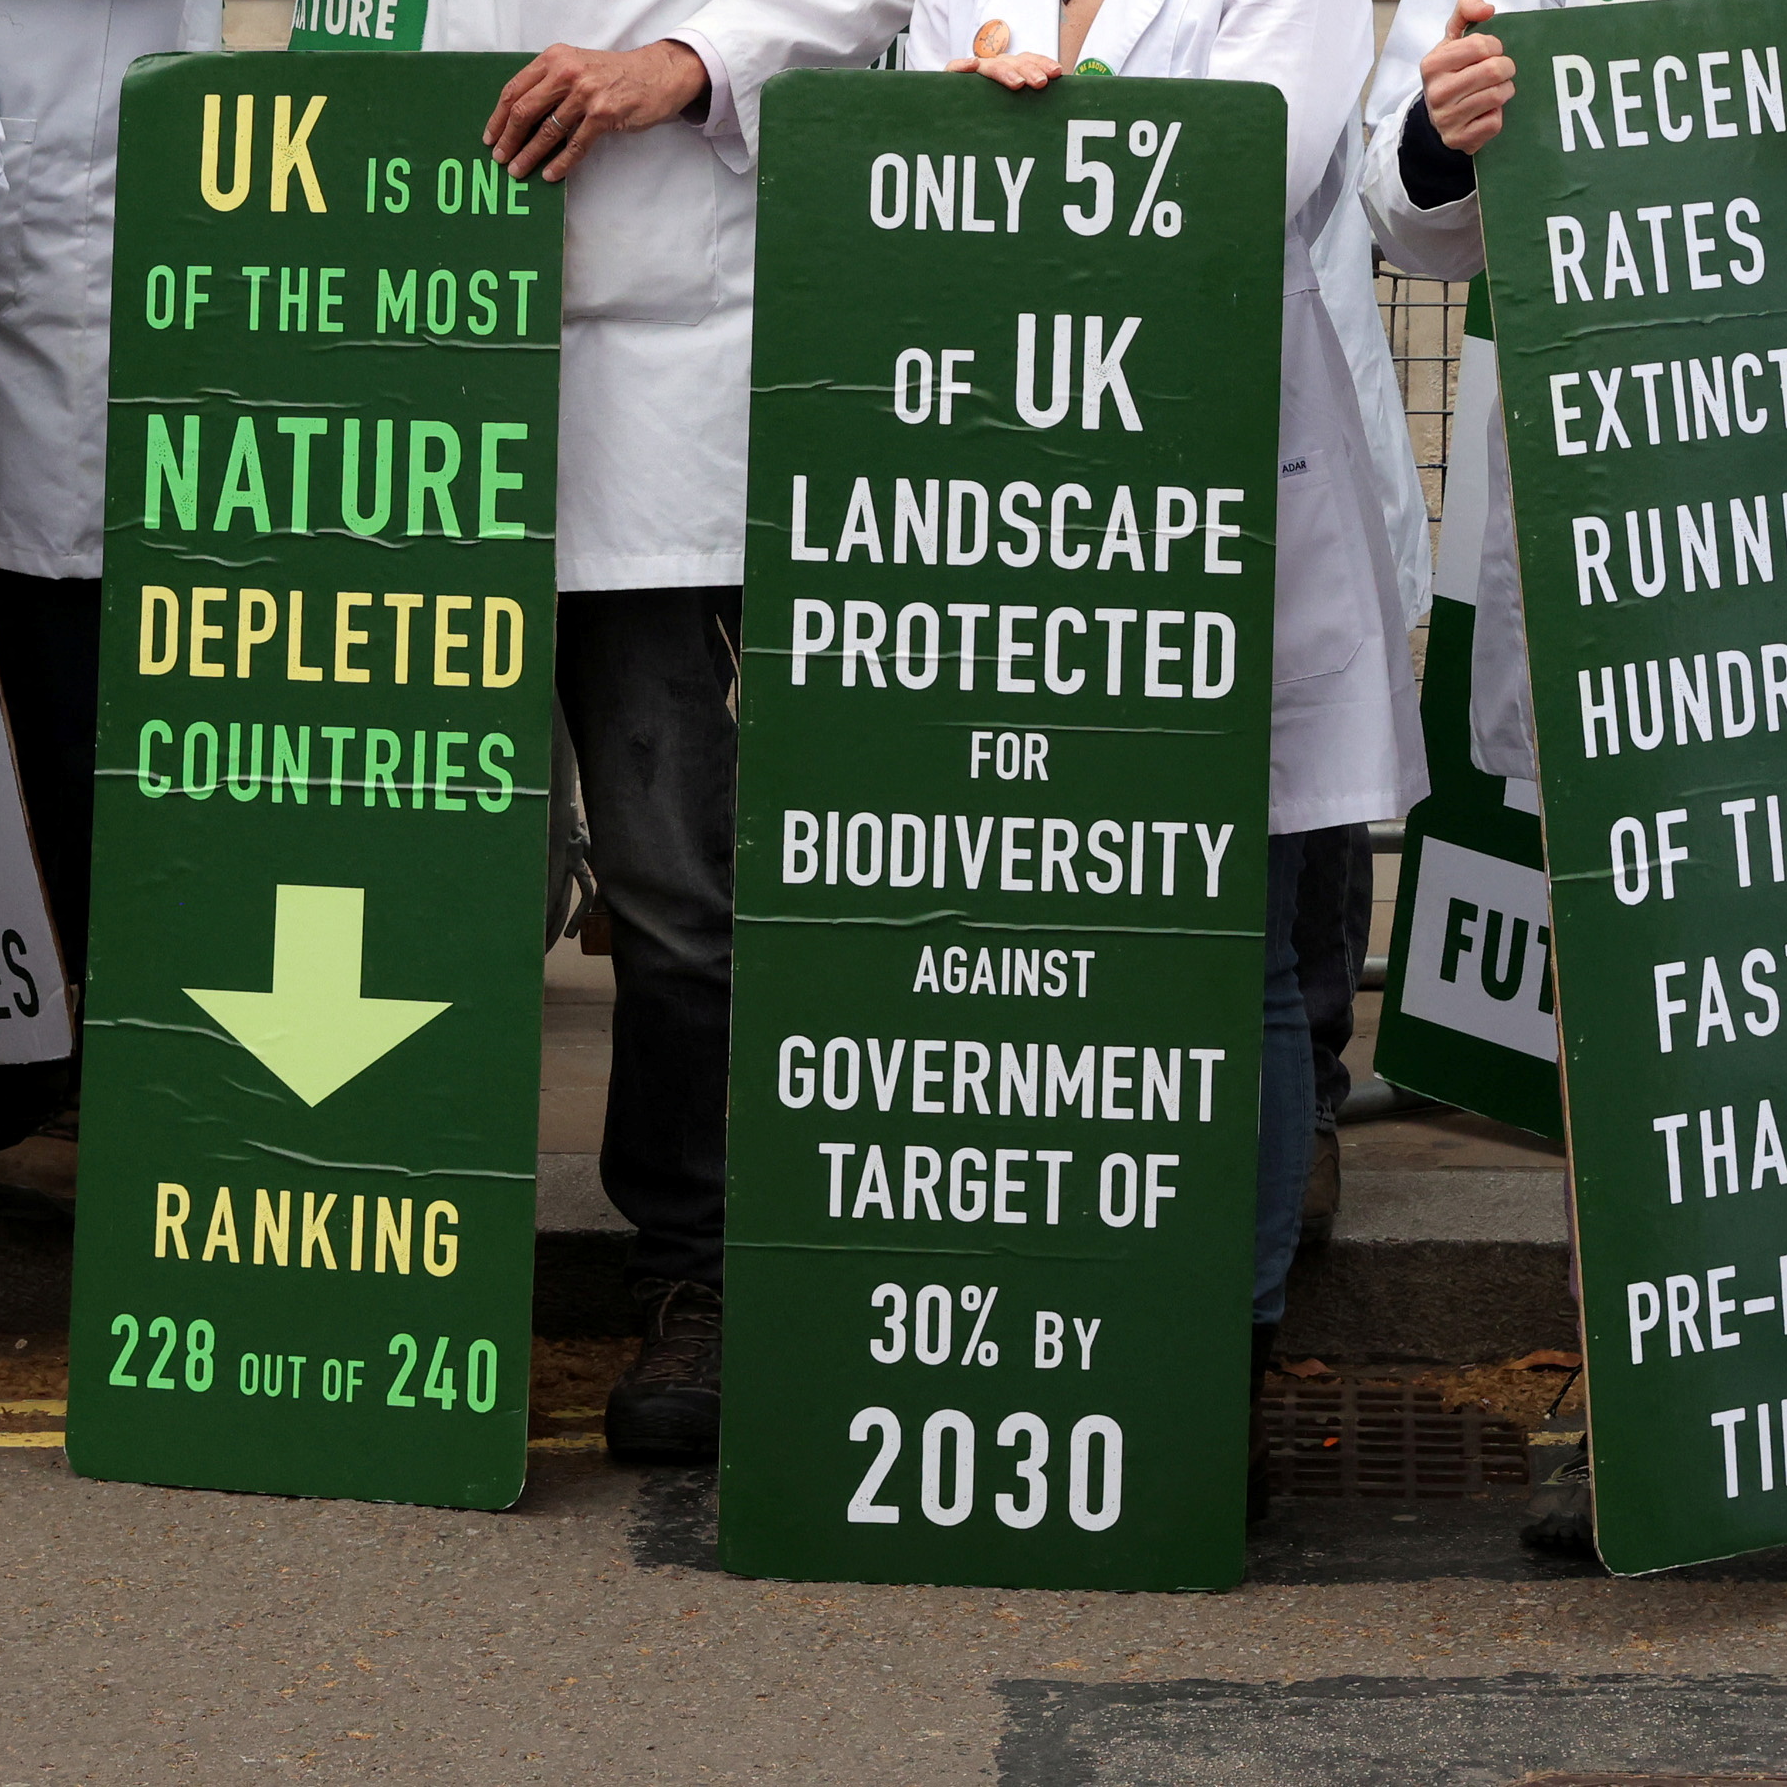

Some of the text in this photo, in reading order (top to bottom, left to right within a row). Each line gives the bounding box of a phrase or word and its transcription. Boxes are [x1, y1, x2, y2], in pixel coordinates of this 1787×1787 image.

[201, 95, 530, 216] UK IS ONE
[871, 120, 1181, 237] ONLY 5%
[1547, 198, 1764, 303] RATES
[147, 265, 537, 335] OF THE MOST
[894, 313, 1145, 433] OF UK
[143, 414, 528, 541] NATURE
[1282, 460, 1307, 474] ADAR
[790, 474, 1245, 576] LANDSCAPE
[140, 586, 523, 688] DEPLETED
[791, 598, 1237, 699] PROTECTED
[137, 719, 516, 813] COUNTRIES
[971, 732, 1048, 780] FOR
[783, 810, 1234, 897] BIODIVERSITY
[1611, 809, 1691, 906] OF
[913, 946, 1095, 997] AGAINST
[779, 1036, 1225, 1121] GOVERNMENT
[155, 1183, 458, 1277] RANKING
[819, 1143, 1179, 1228] TARGET OF
[109, 1314, 497, 1412] 228 OUT OF 240
[871, 1283, 1101, 1370] 30% BY
[848, 1407, 1122, 1531] 2030
